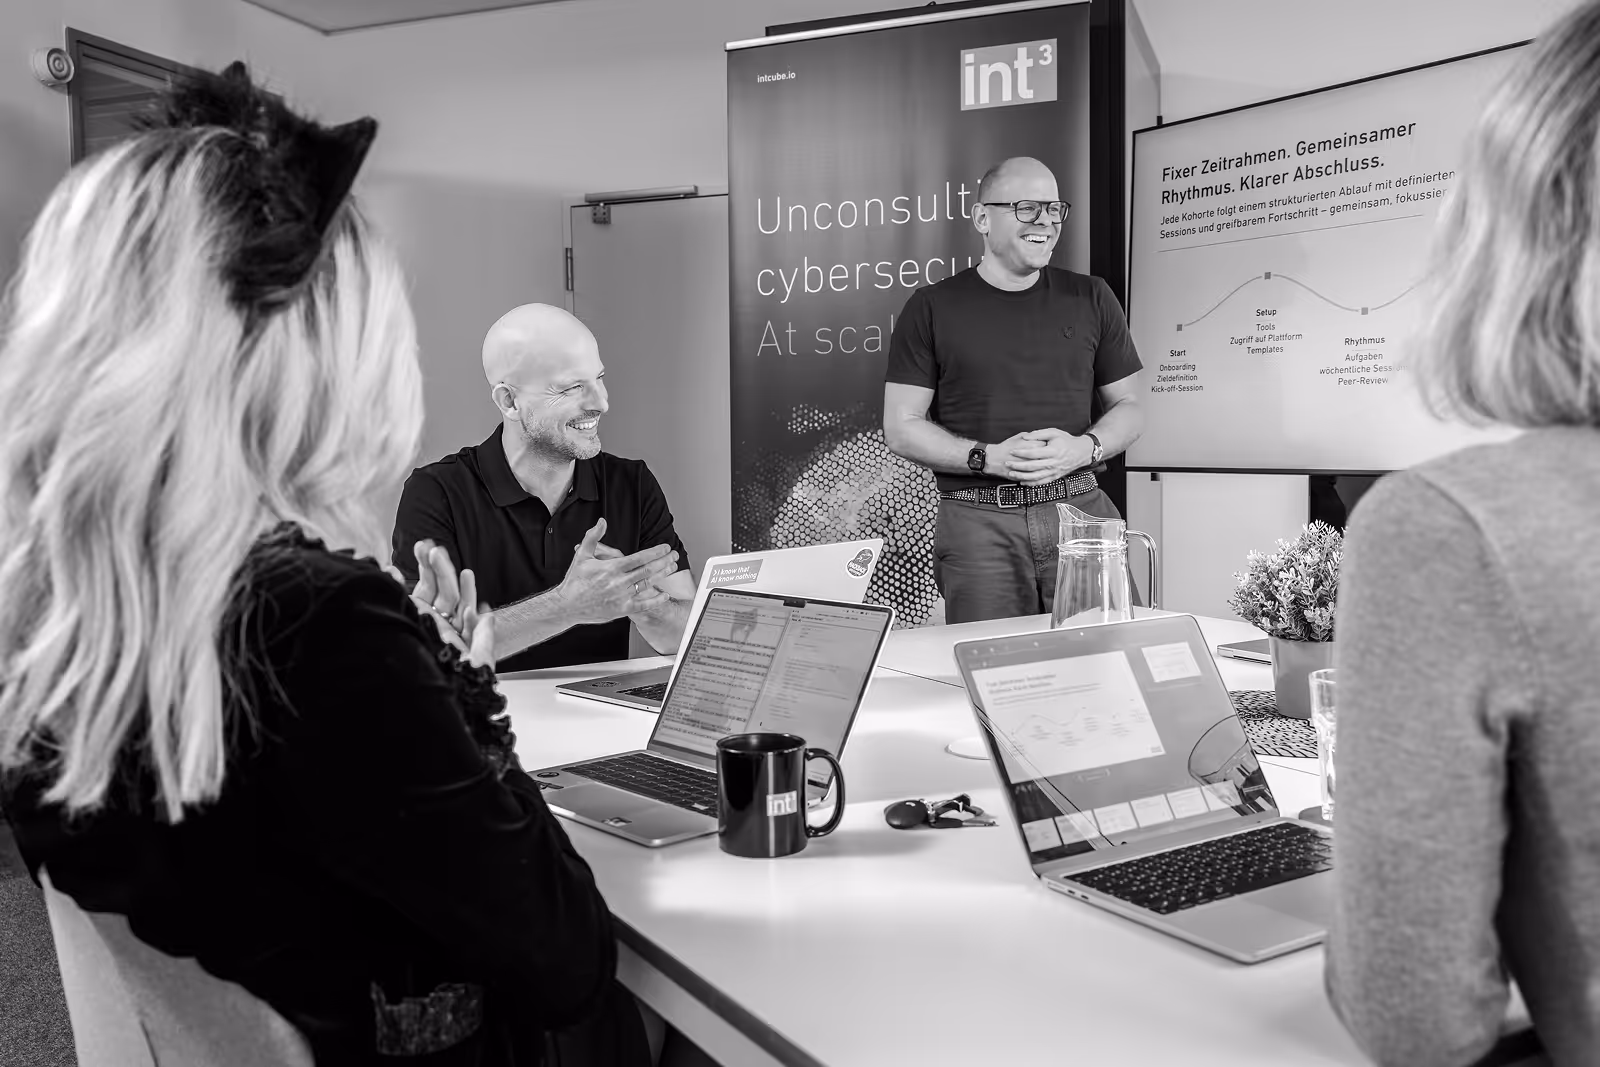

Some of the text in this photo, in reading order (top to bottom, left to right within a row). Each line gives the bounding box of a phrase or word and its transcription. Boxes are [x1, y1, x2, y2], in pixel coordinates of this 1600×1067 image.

[757, 70, 796, 83] intcube.io
[1162, 122, 1416, 182] Fixer Zeitrahmen. Gemeinsamer
[1161, 156, 1384, 205] Rhythmus. Klarer Abschluss.
[1160, 171, 1456, 225] Jede Kohorte folgt einem strukturierten Ablauf mit definierten
[757, 179, 982, 234] Unconsult
[1160, 227, 1197, 239] Sessions
[1198, 222, 1214, 234] und
[1216, 216, 1266, 233] greifbarem
[1268, 207, 1319, 223] Fortschritt
[1329, 196, 1393, 216] gemeinsam,
[1256, 308, 1277, 317] Setup
[1256, 323, 1276, 331] Tools
[757, 320, 797, 356] At
[1230, 332, 1303, 345] Zugriff auf Plattform
[1344, 336, 1386, 346] Rhythmus
[1170, 349, 1186, 357] Start
[1246, 346, 1284, 355] Templates
[1344, 352, 1383, 362] Aufgaben
[1159, 363, 1196, 372] Onboarding
[1319, 365, 1371, 375] wöchentliche
[1157, 373, 1198, 382] Zieldefinition
[1338, 376, 1388, 386] Peer-Review
[1151, 384, 1204, 393] Kick-off-Session
